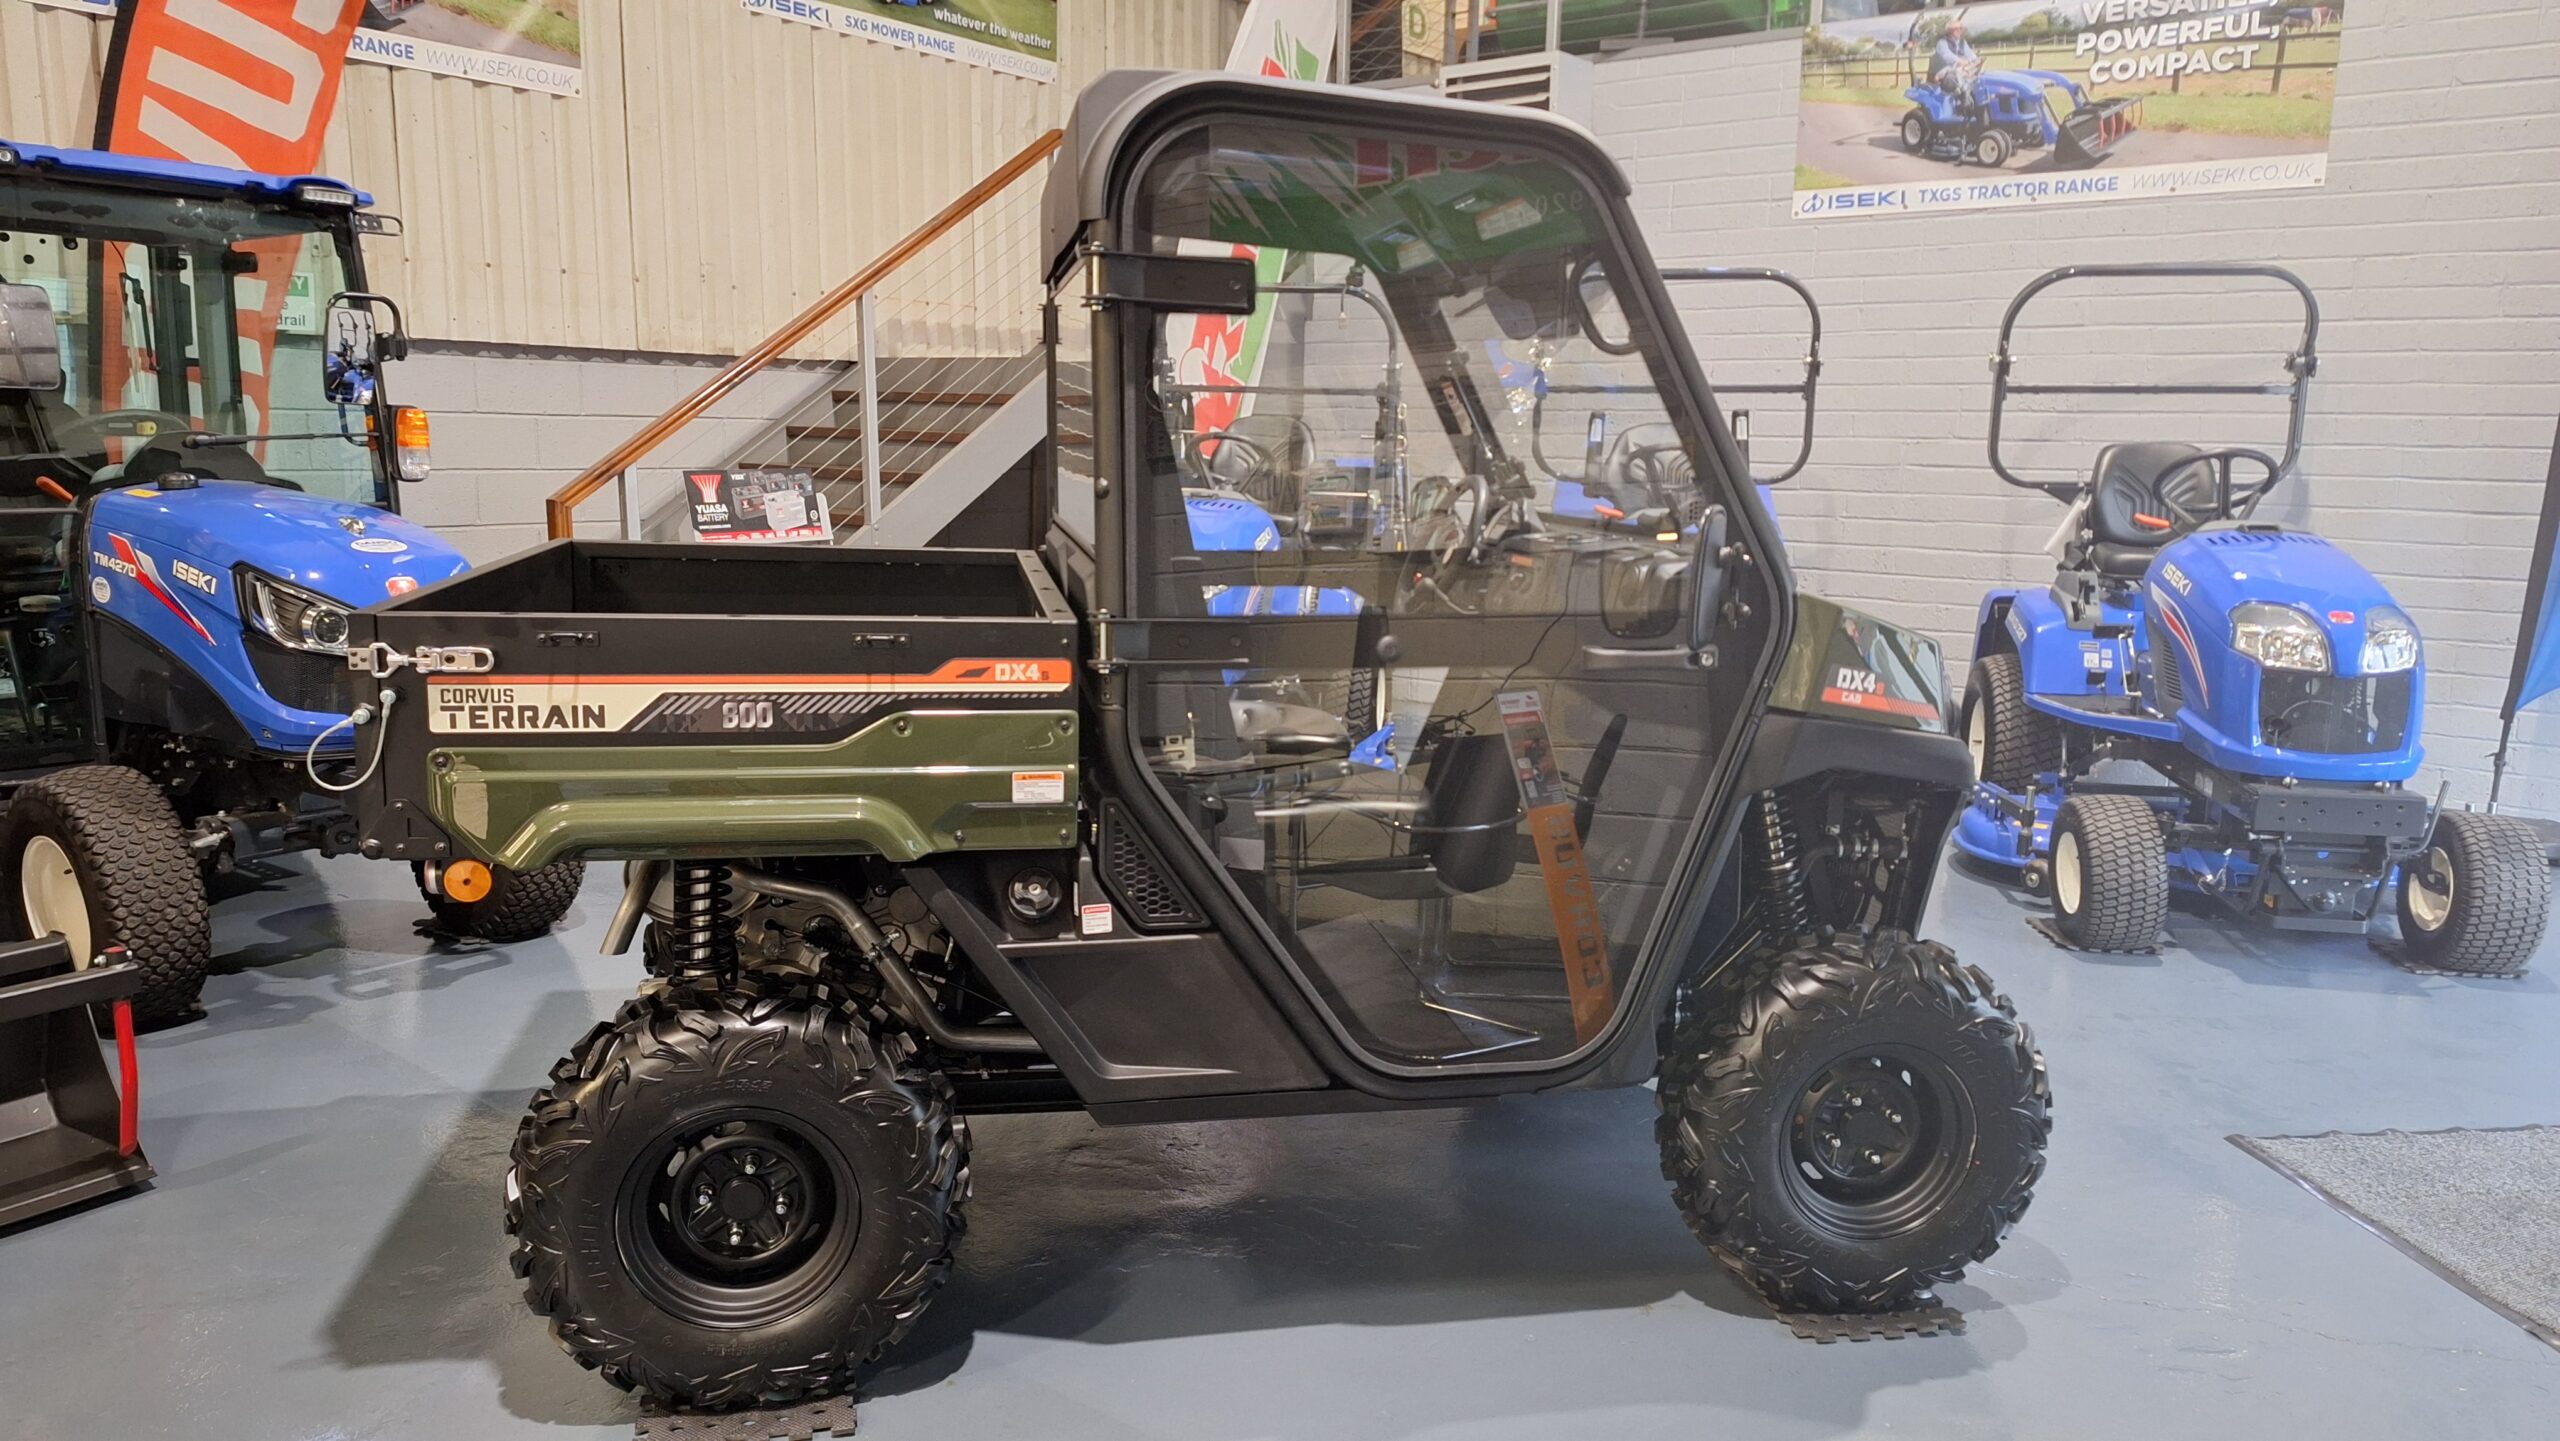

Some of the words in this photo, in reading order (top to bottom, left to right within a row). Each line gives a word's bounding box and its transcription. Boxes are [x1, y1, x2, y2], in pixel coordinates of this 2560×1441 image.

[933, 7, 987, 32] whatever
[988, 18, 1009, 37] the
[1010, 25, 1053, 50] weather
[2082, 0, 2279, 25] VERSA,
[770, 0, 832, 23] ISEKI
[844, 14, 869, 31] SXG
[870, 21, 915, 43] MOWER
[917, 34, 956, 54] RANGE
[966, 45, 1055, 77] WWW.ISEKI.CO.UK
[2075, 10, 2281, 56] POWERFUL,
[352, 34, 415, 60] RANGE
[426, 48, 575, 89] WWW.ISEKI.CO.UK
[2089, 43, 2260, 84] COMPACT
[1828, 190, 1906, 210] ISEKI
[1919, 187, 1962, 204] TXGS
[1968, 181, 2049, 202] TRACTOR
[2054, 176, 2119, 196] RANGE
[2132, 163, 2315, 189] WWW.ISEKI.CO.UK
[695, 504, 729, 514] YUASA
[697, 513, 730, 523] BATTERY
[93, 551, 136, 578] TM4270
[172, 559, 217, 595] ISEKI
[2161, 561, 2193, 597] ISEKI
[440, 688, 514, 704] CORVUS
[440, 704, 606, 729] TERRAIN
[722, 702, 773, 729] 800
